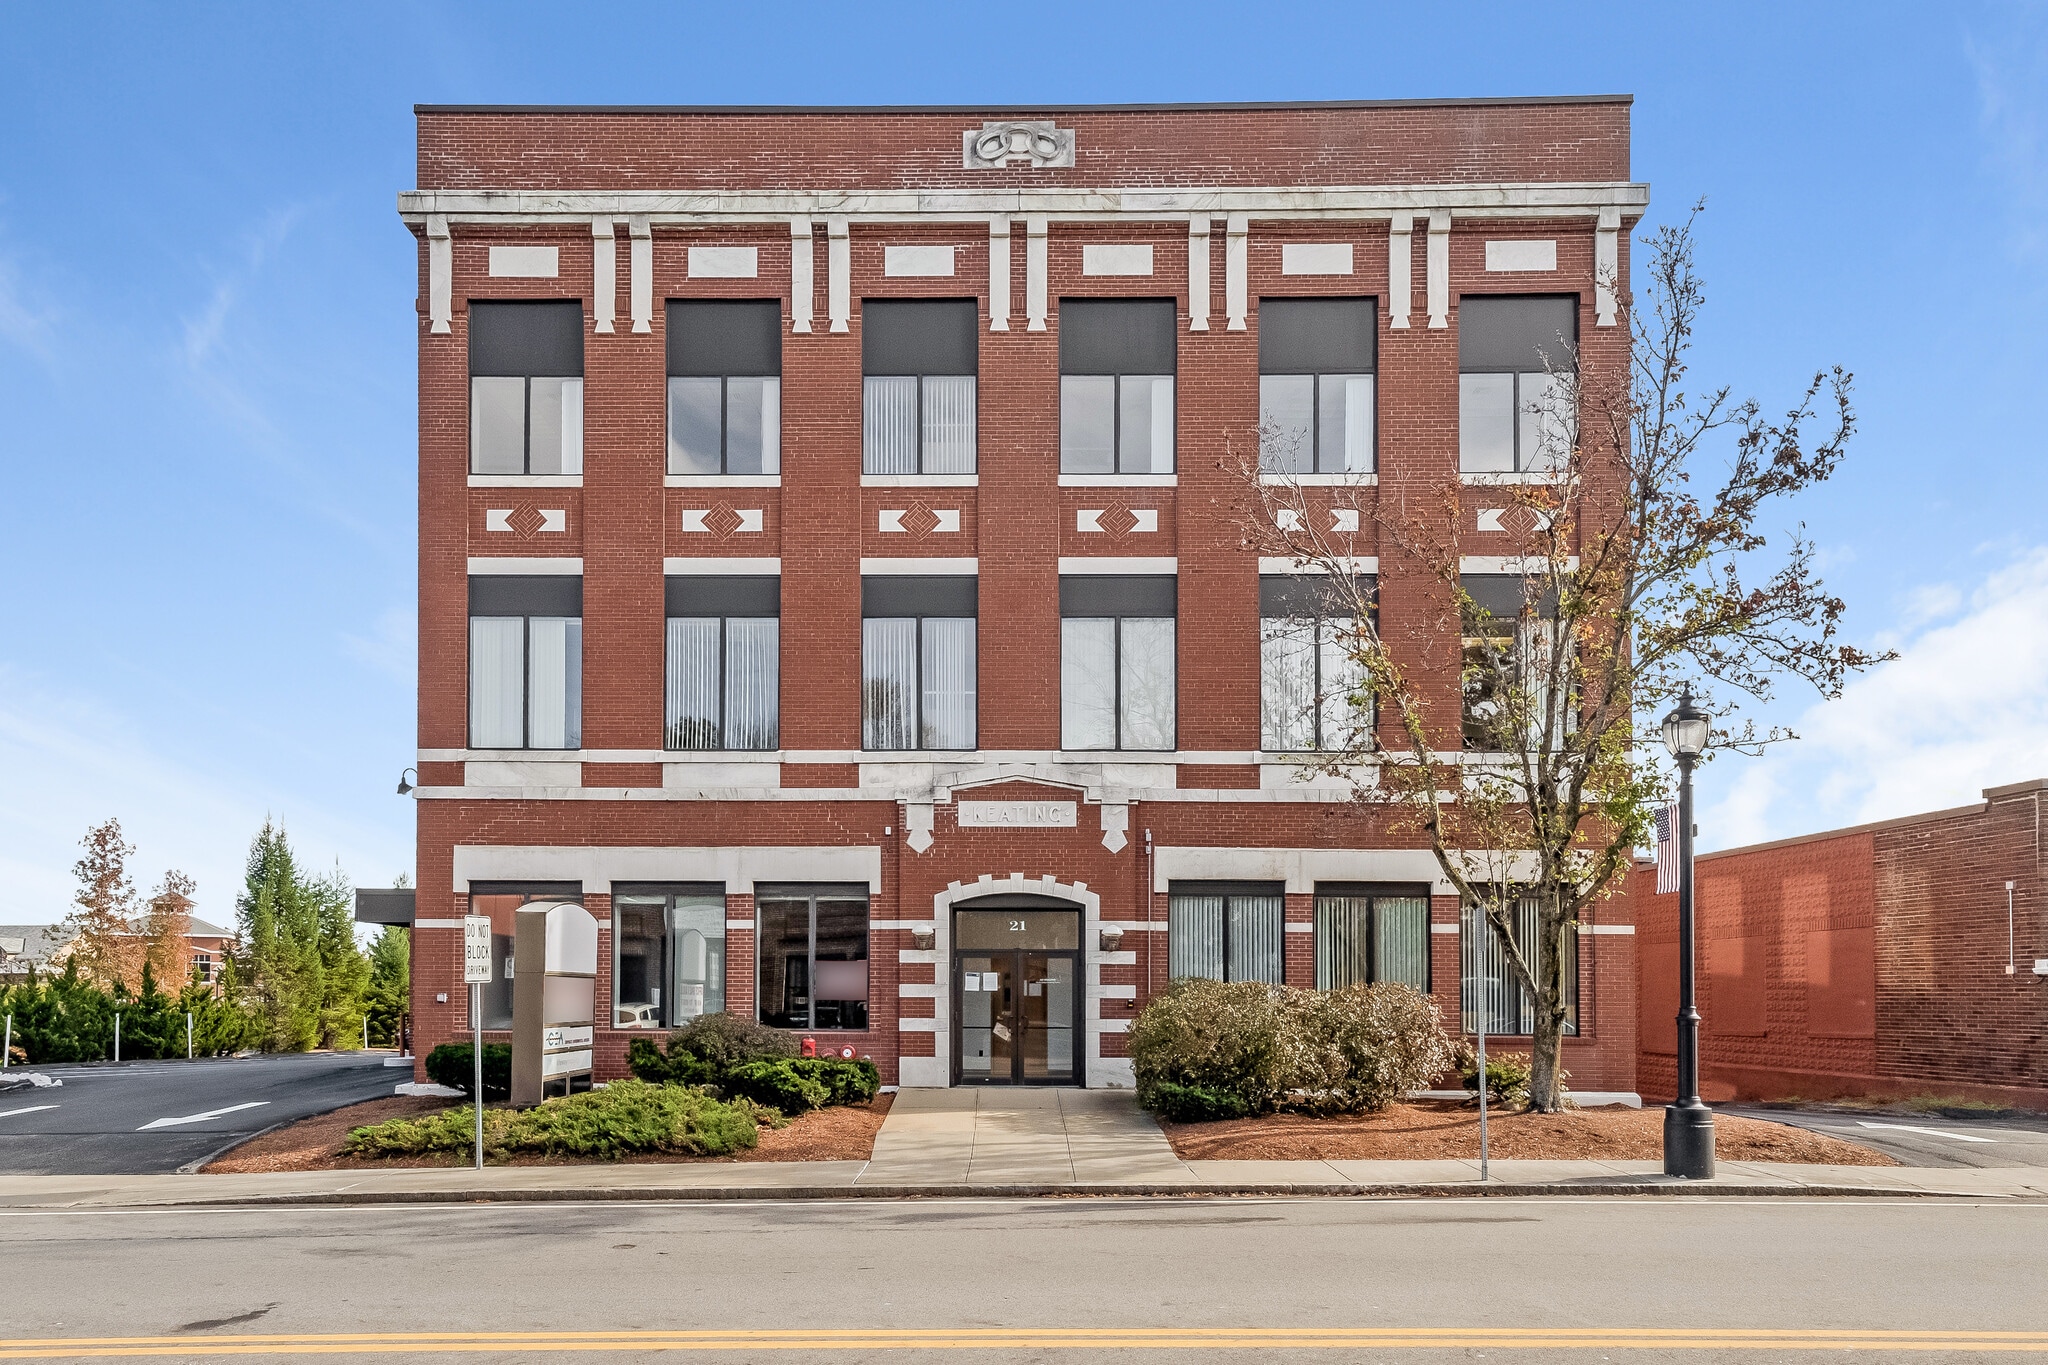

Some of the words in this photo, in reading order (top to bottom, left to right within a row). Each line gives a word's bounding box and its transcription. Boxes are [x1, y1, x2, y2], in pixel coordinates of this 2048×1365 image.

[972, 806, 1061, 823] KEATING
[467, 923, 476, 938] DO
[478, 924, 489, 938] NOT
[1009, 920, 1027, 931] 21
[467, 945, 490, 959] BLOCK
[467, 965, 489, 975] DRIVEWAY
